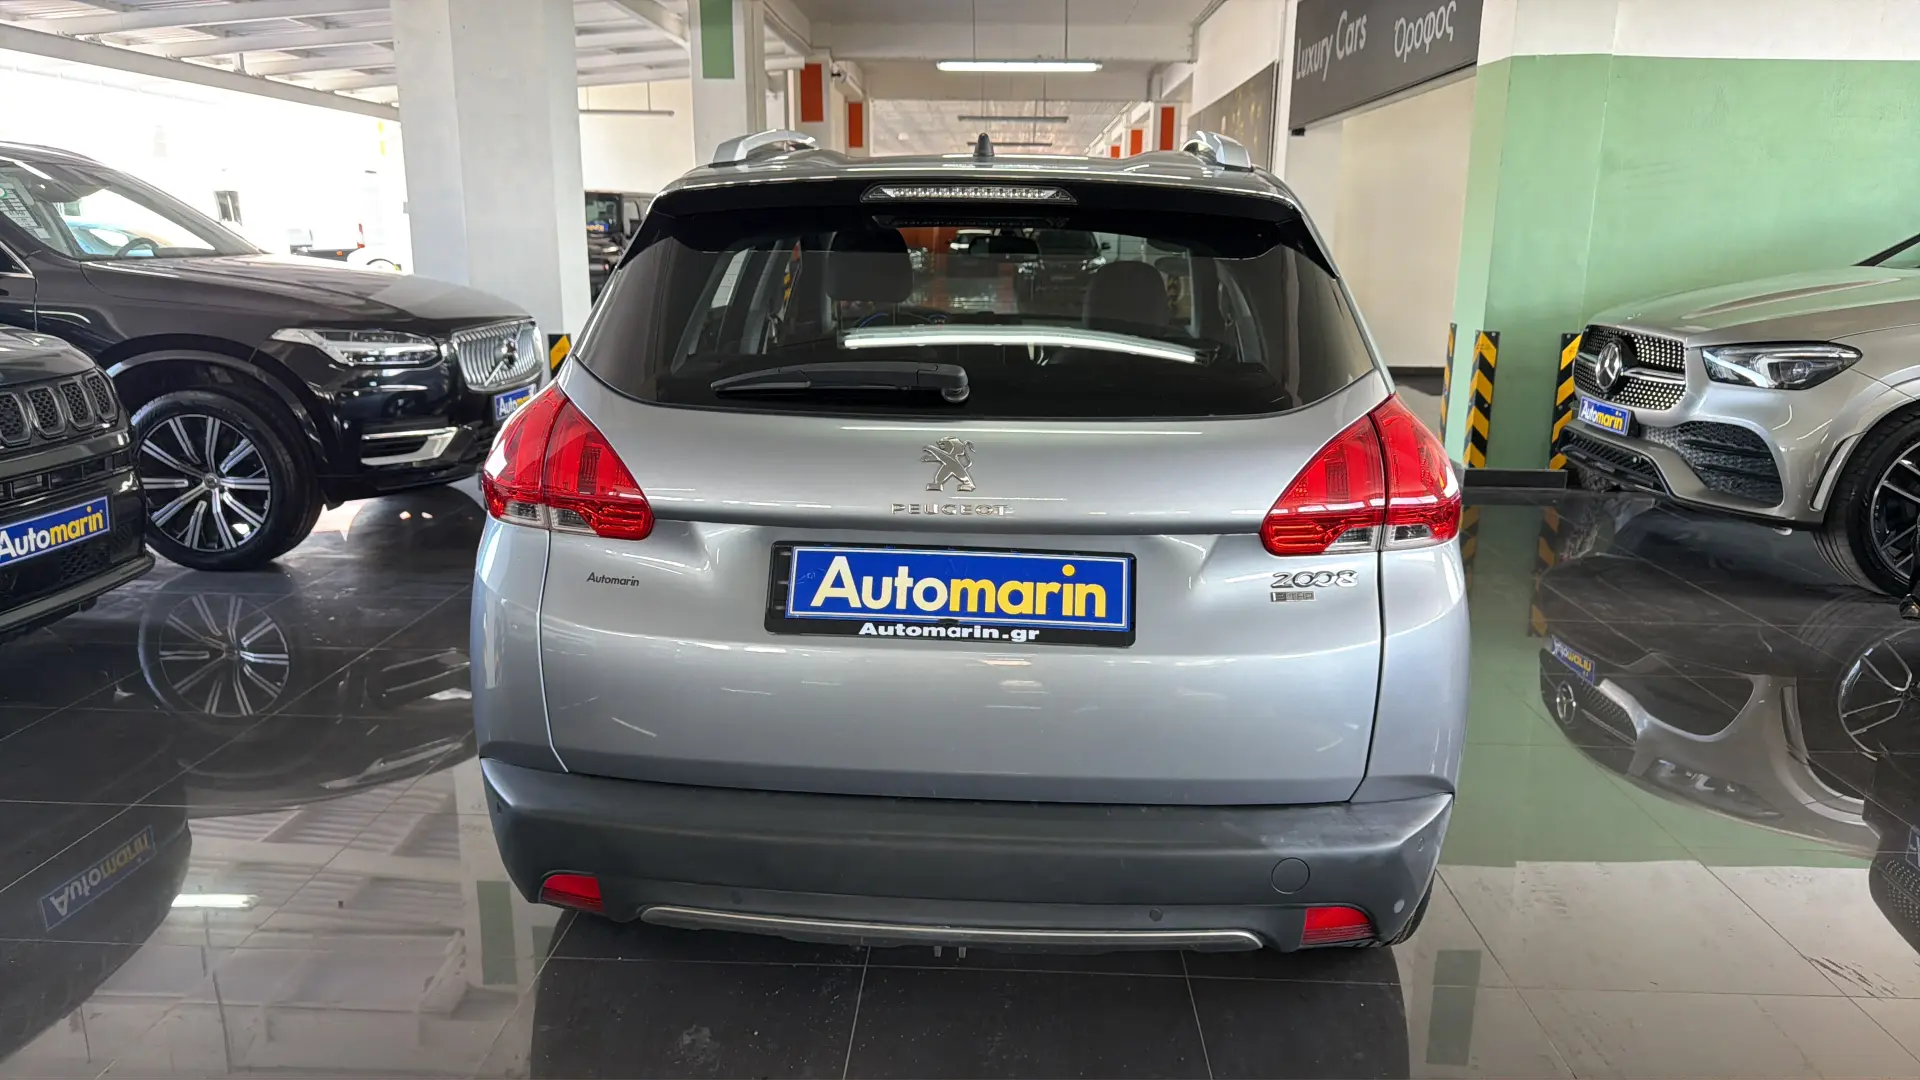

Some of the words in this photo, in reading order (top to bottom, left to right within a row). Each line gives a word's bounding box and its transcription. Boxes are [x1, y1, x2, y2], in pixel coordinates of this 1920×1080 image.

[1296, 34, 1334, 82] Luxury
[1336, 10, 1367, 60] Cars
[1581, 400, 1623, 430] Automarin
[891, 503, 1009, 515] PEUGEOT
[0, 505, 103, 558] Automarin
[586, 572, 640, 587] Automarin
[810, 555, 1107, 618] Automarin
[1270, 570, 1358, 588] 2008
[859, 622, 1040, 642] Automarin.gr
